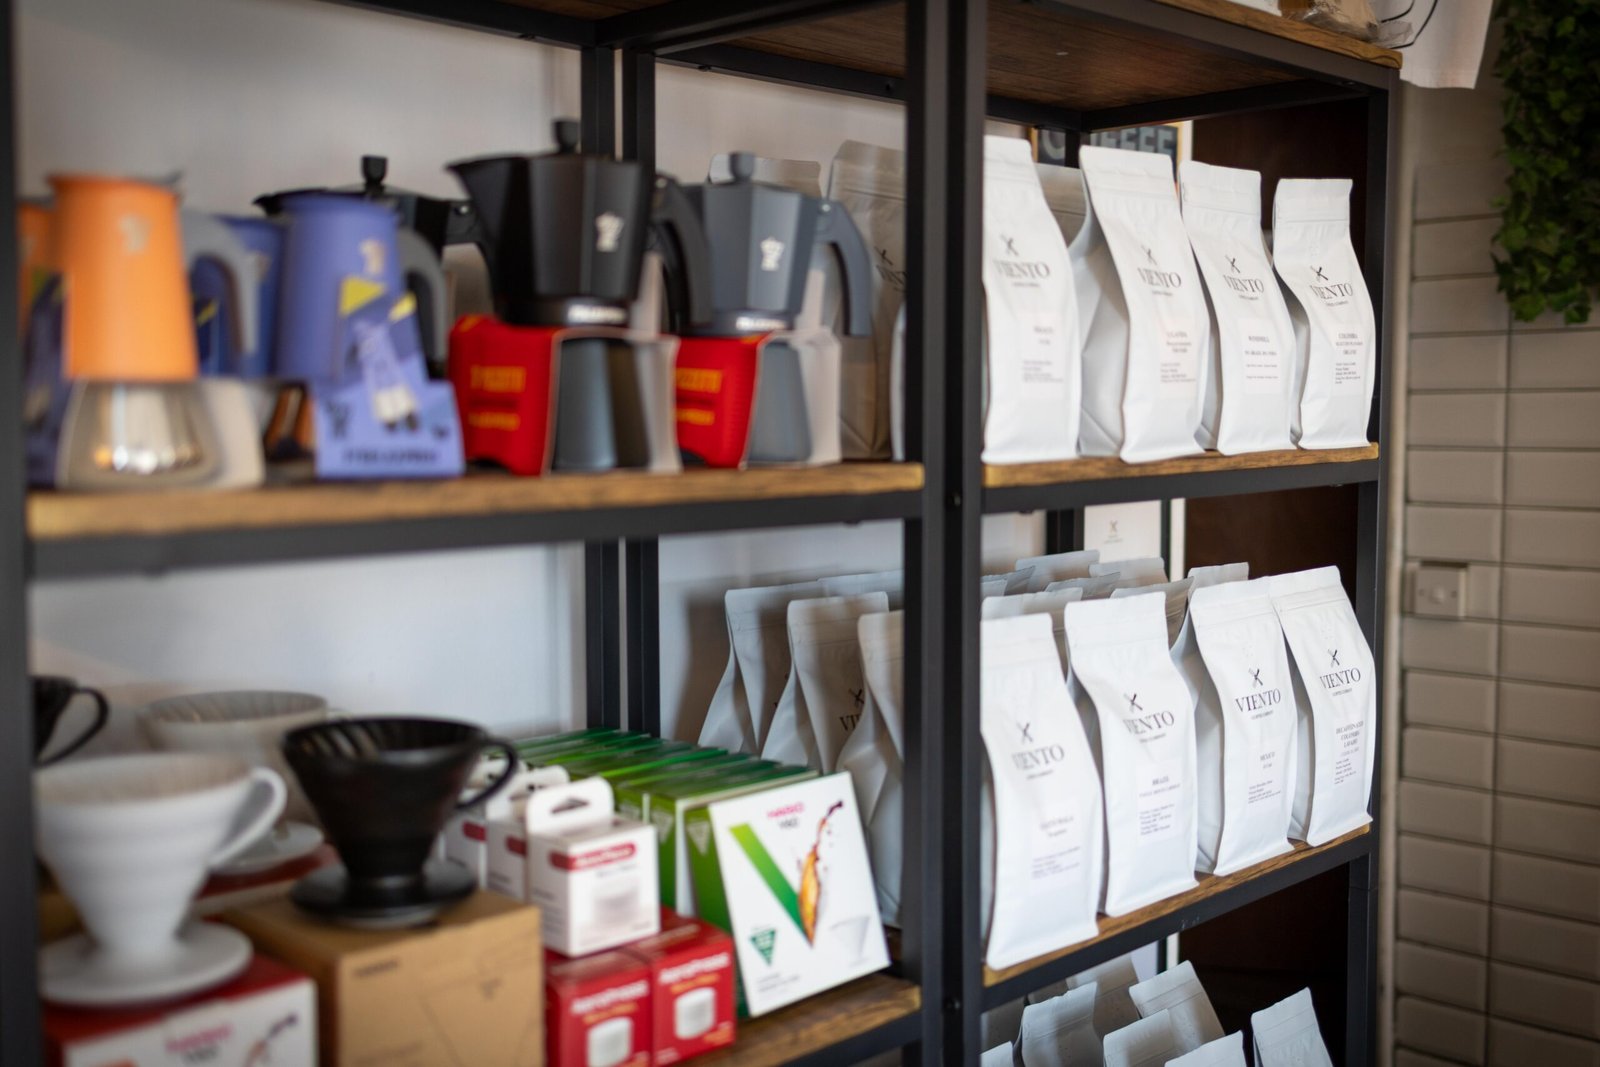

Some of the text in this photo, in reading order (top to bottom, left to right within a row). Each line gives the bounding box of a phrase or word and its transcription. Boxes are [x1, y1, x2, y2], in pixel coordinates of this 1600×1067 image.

[1137, 268, 1182, 289] VIENTO
[1223, 274, 1265, 293] VIENTO
[1309, 282, 1354, 299] VIENTO
[1319, 667, 1361, 689] VIENTO
[1235, 688, 1281, 712] VIENTO
